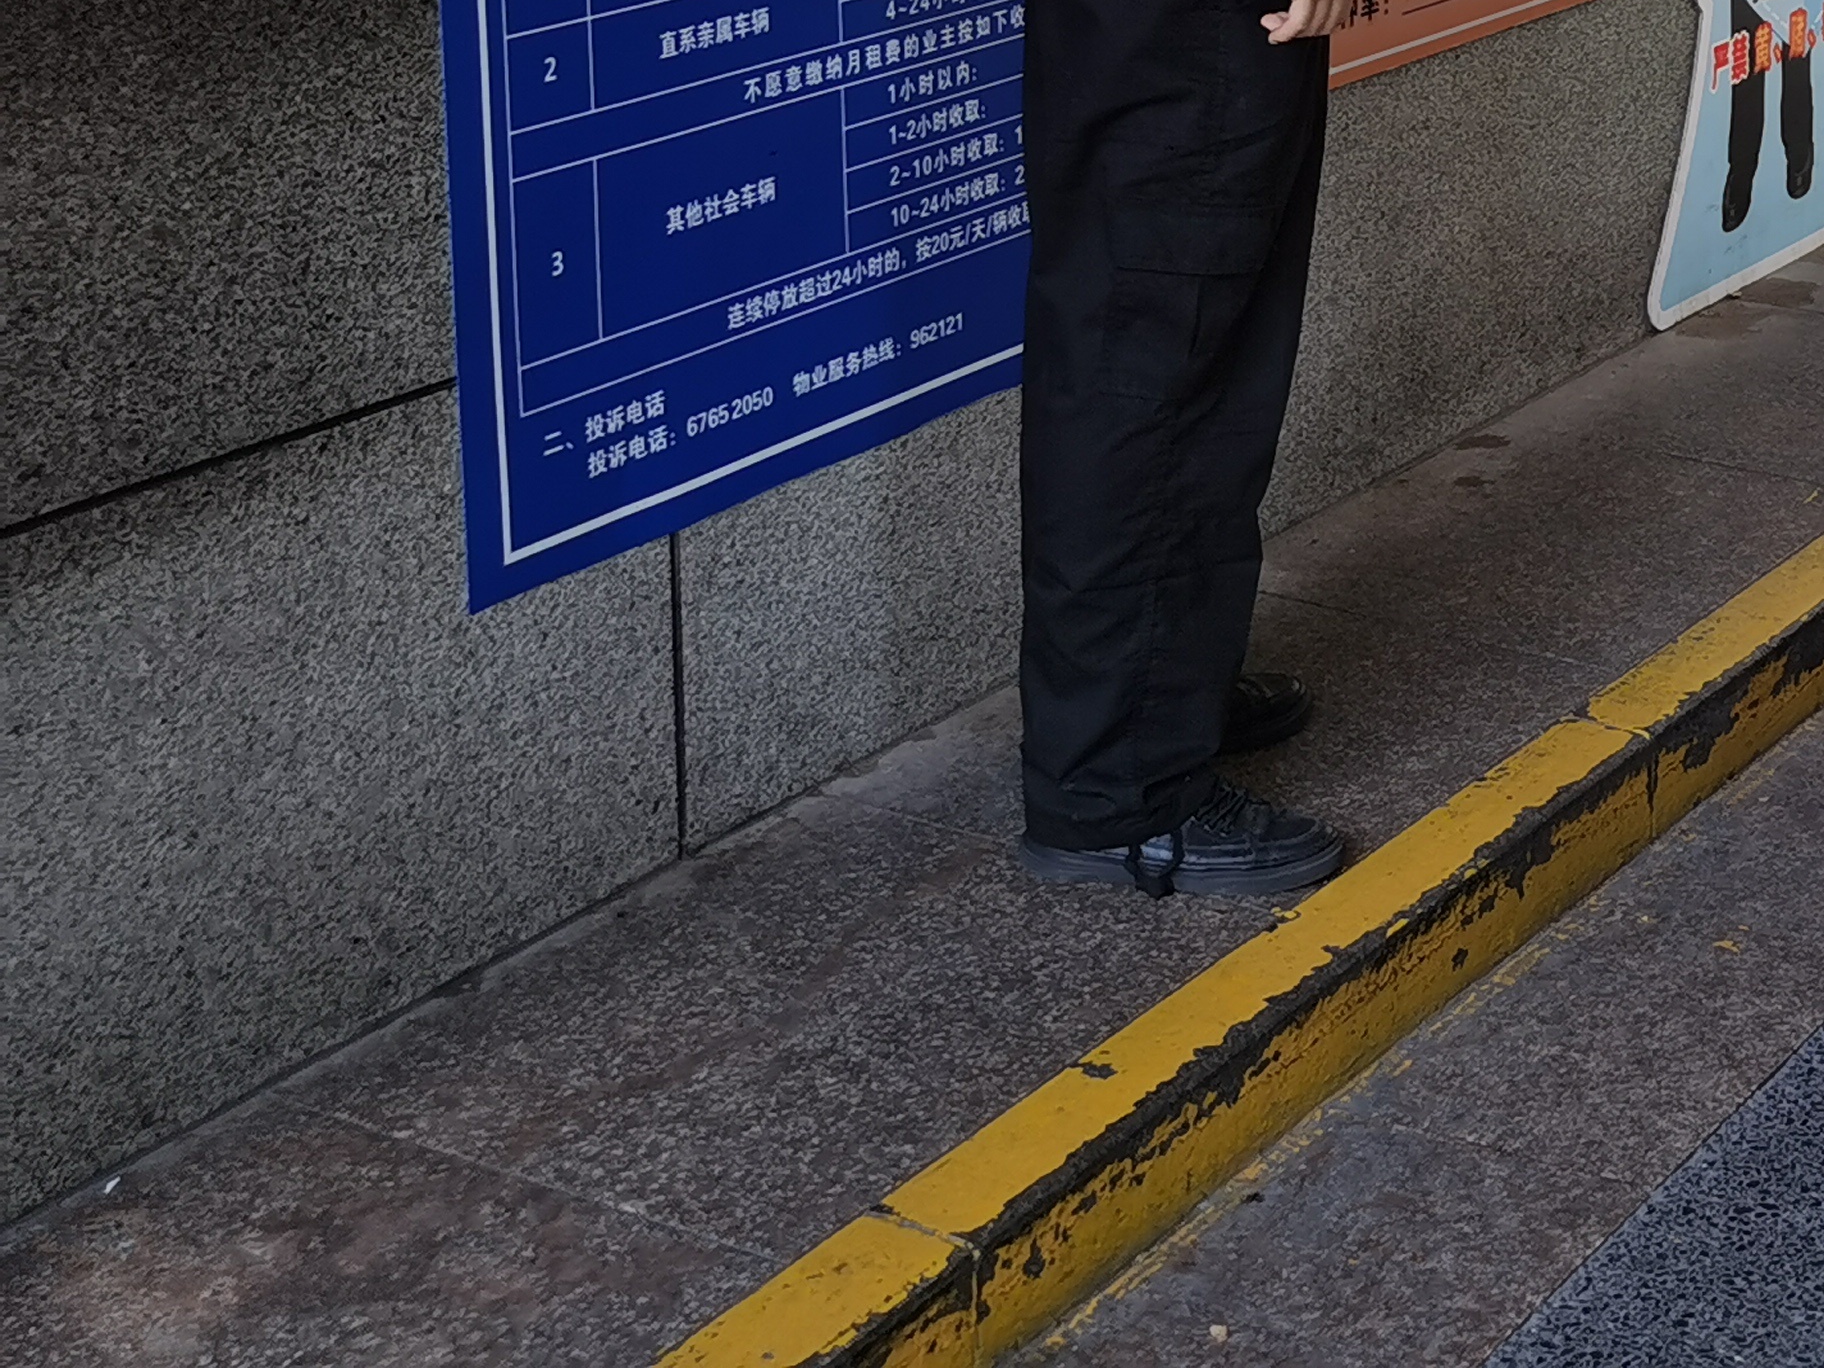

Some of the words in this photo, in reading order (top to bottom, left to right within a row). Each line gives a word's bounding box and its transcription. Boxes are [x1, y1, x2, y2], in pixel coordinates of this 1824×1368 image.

[659, 6, 770, 60] 直系亲属车辆
[543, 56, 558, 83] 2
[665, 177, 777, 236] 其他社会车辆
[551, 250, 566, 278] 3
